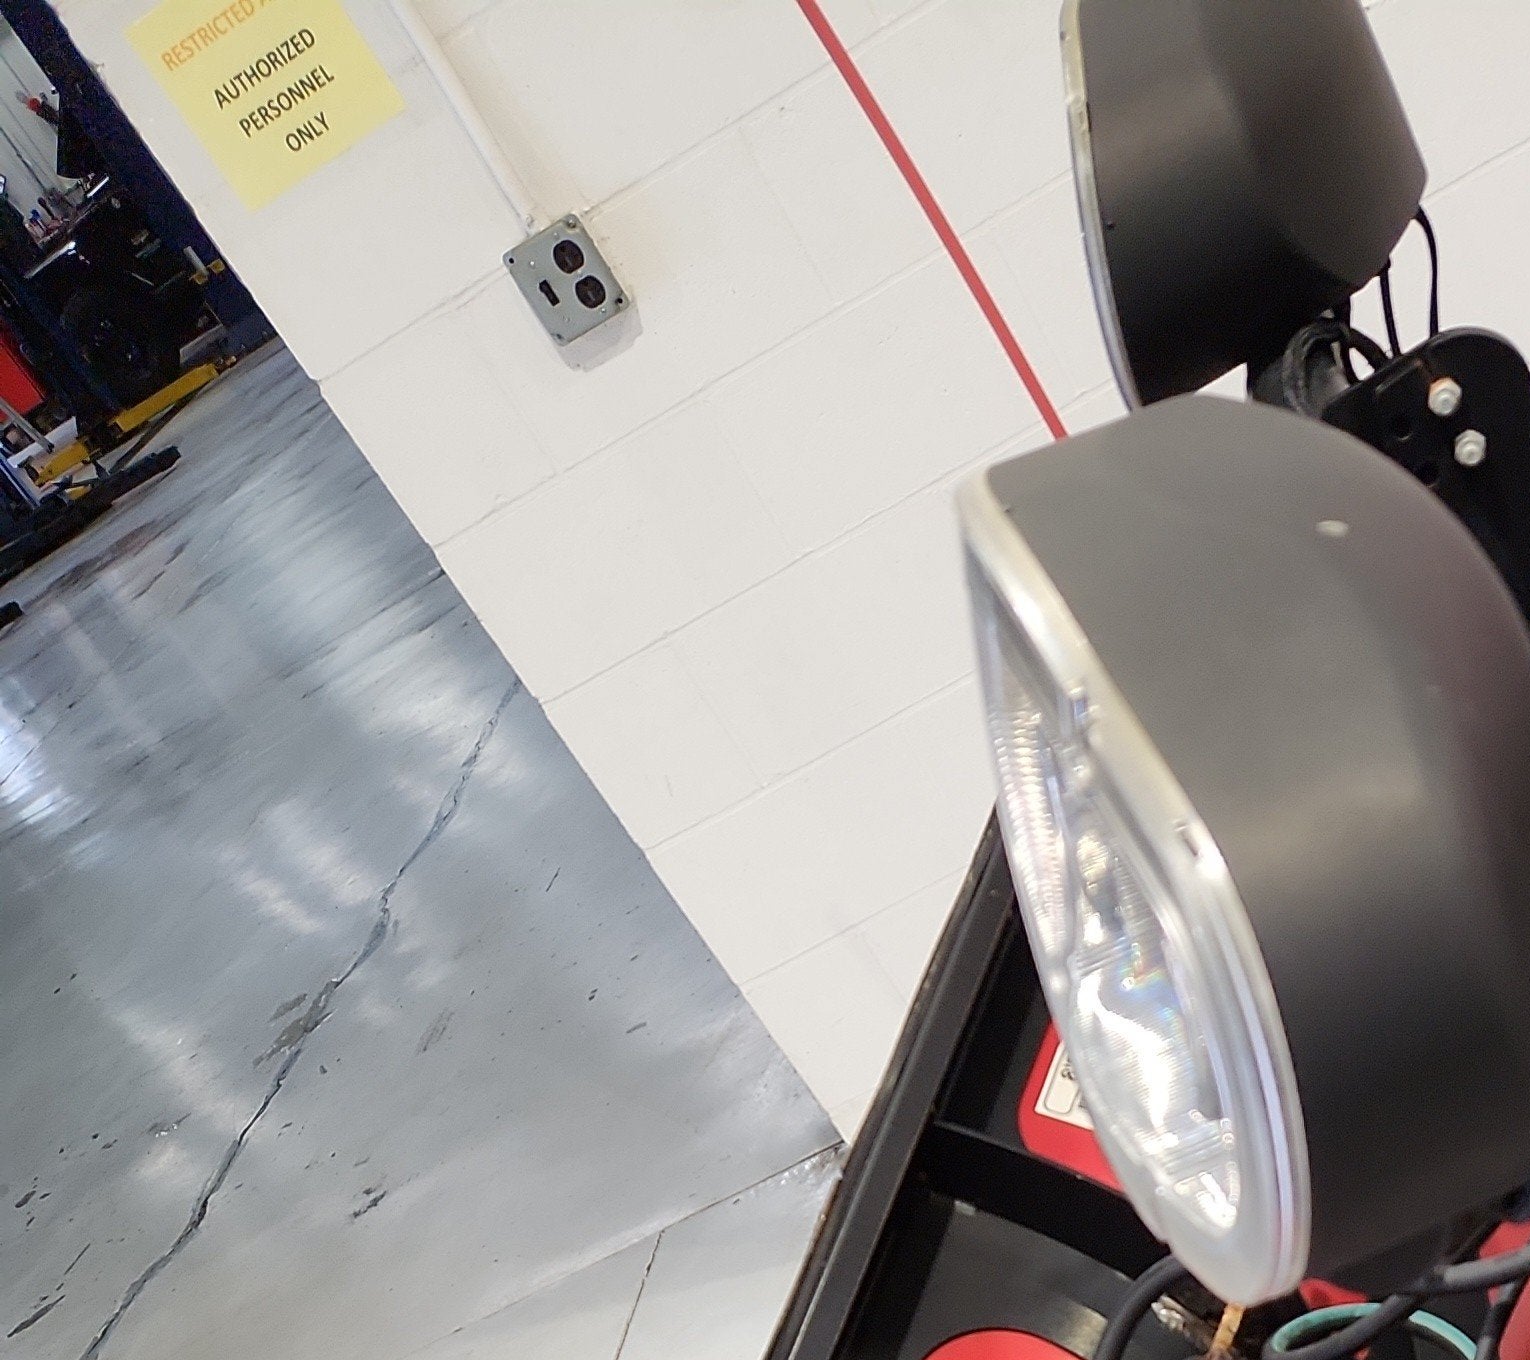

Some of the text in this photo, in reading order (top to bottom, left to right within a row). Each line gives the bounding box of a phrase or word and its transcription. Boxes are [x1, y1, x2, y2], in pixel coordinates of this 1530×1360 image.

[161, 0, 256, 71] RESTRICTED
[213, 28, 316, 110] AUTHORIZED
[238, 64, 335, 138] PERSONNEL
[285, 111, 330, 152] ONLY
